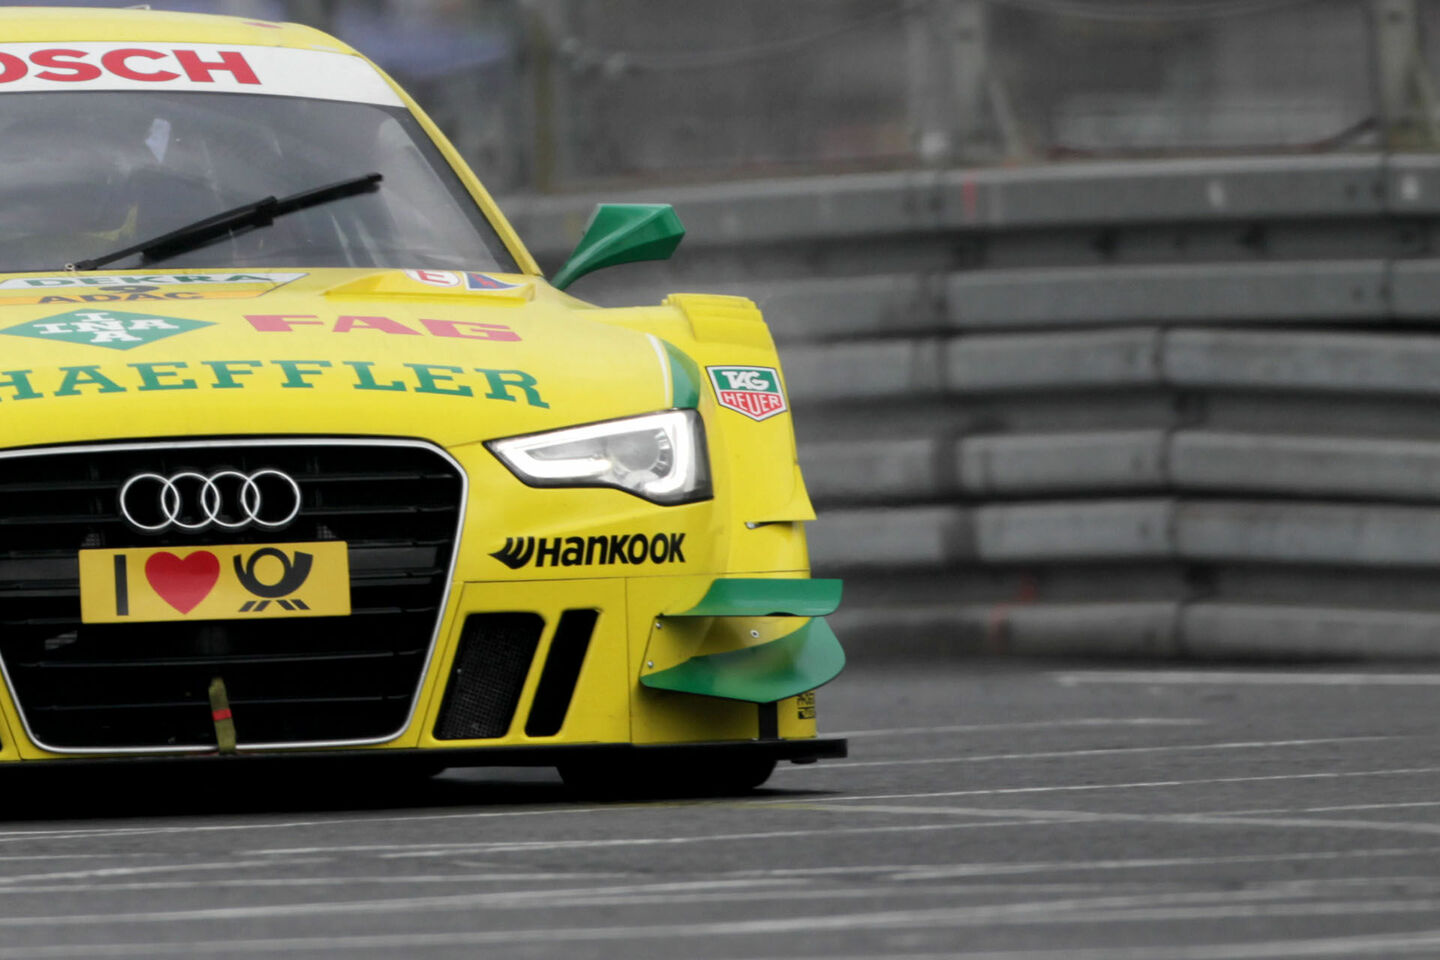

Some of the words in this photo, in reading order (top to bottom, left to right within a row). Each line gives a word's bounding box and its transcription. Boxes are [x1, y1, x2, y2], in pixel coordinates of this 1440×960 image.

[25, 274, 274, 287] DEKRA
[37, 292, 206, 304] ADAC
[33, 319, 180, 335] INA
[242, 314, 524, 342] FAG
[721, 371, 770, 391] TAG
[722, 392, 781, 415] HEUER
[113, 554, 130, 617] I
